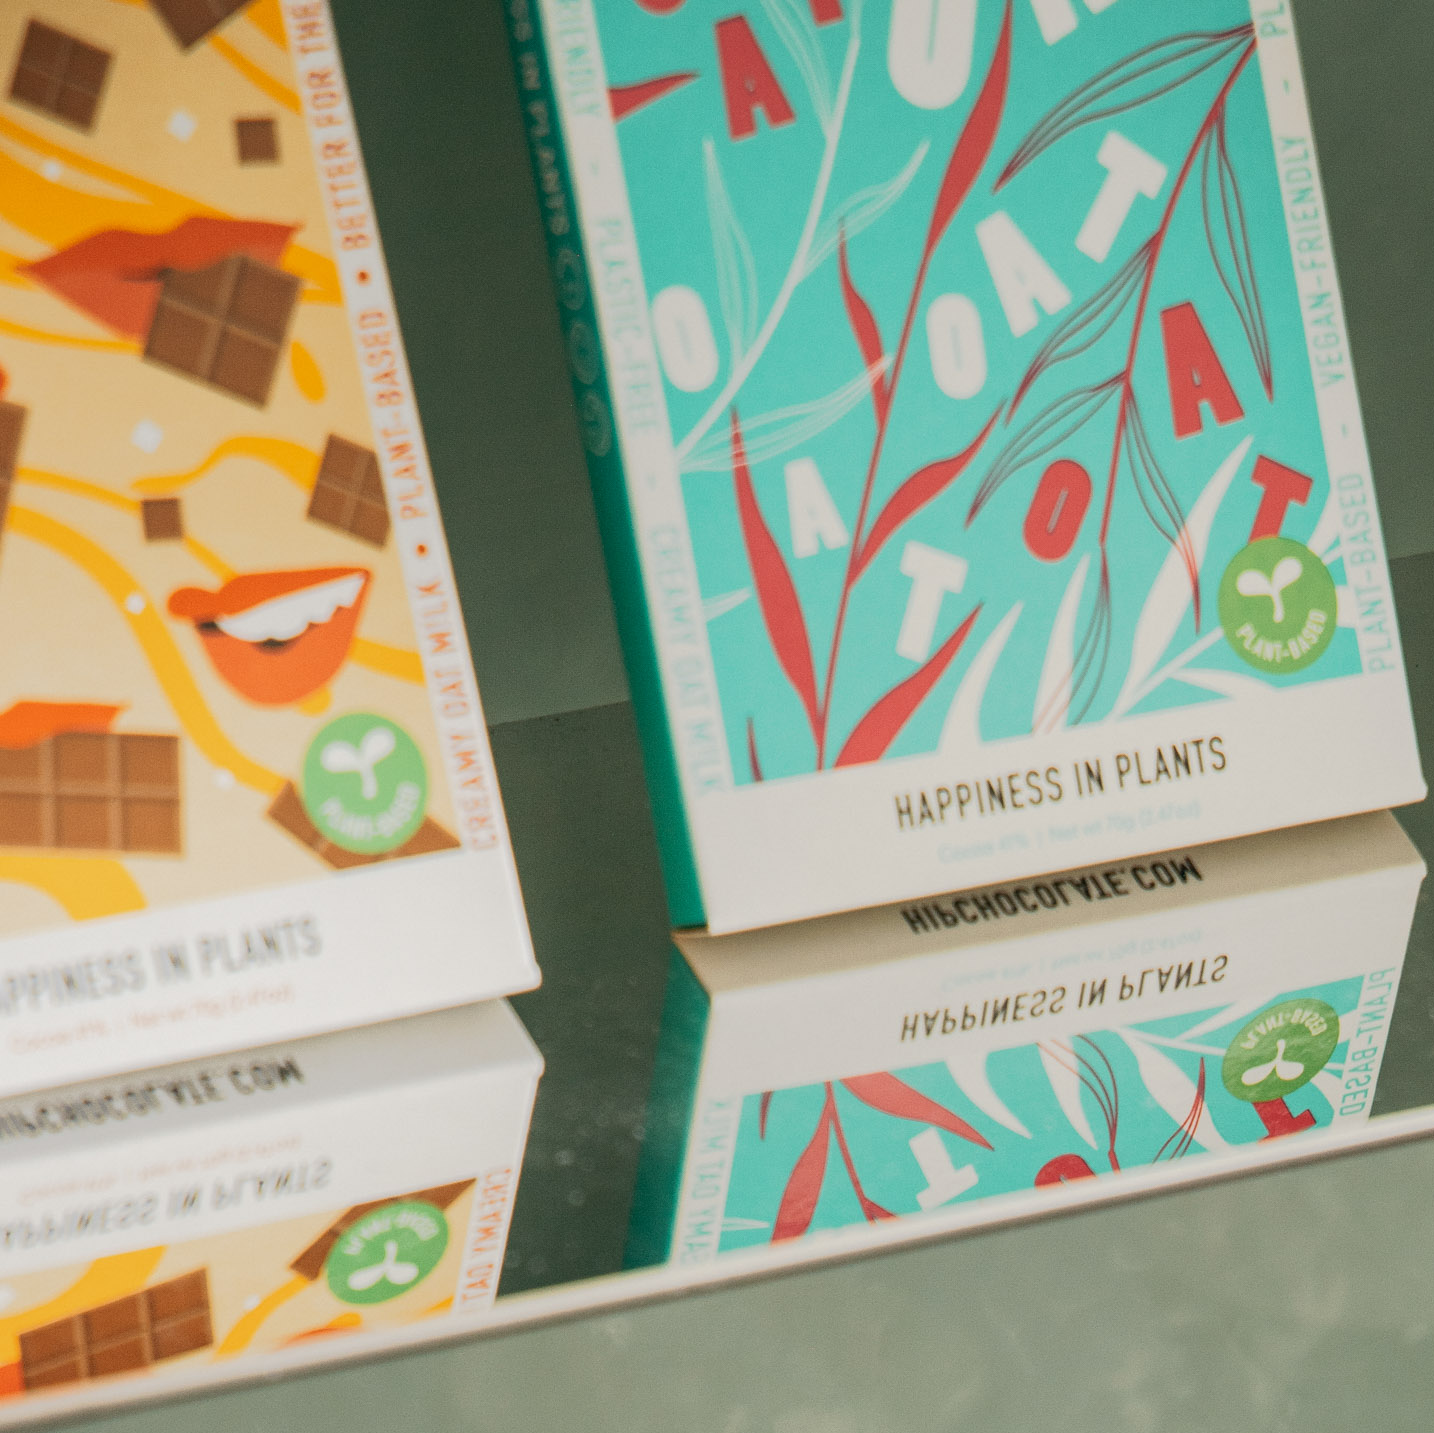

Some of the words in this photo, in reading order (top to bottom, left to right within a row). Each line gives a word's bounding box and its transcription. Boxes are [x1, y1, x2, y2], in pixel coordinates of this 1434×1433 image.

[307, 68, 345, 128] FOR
[320, 135, 368, 251] BETTER
[1275, 133, 1347, 389] VEGAN-FRIENDLY
[355, 307, 430, 521] PLANT-BASED
[1338, 471, 1397, 676] PLANT-BASED
[1235, 608, 1328, 667] PLANT-BASED
[894, 767, 1064, 832] HAPPINESS
[1073, 759, 1107, 798] IN
[1116, 735, 1228, 792] PLANTS
[200, 914, 324, 977] PLANTS
